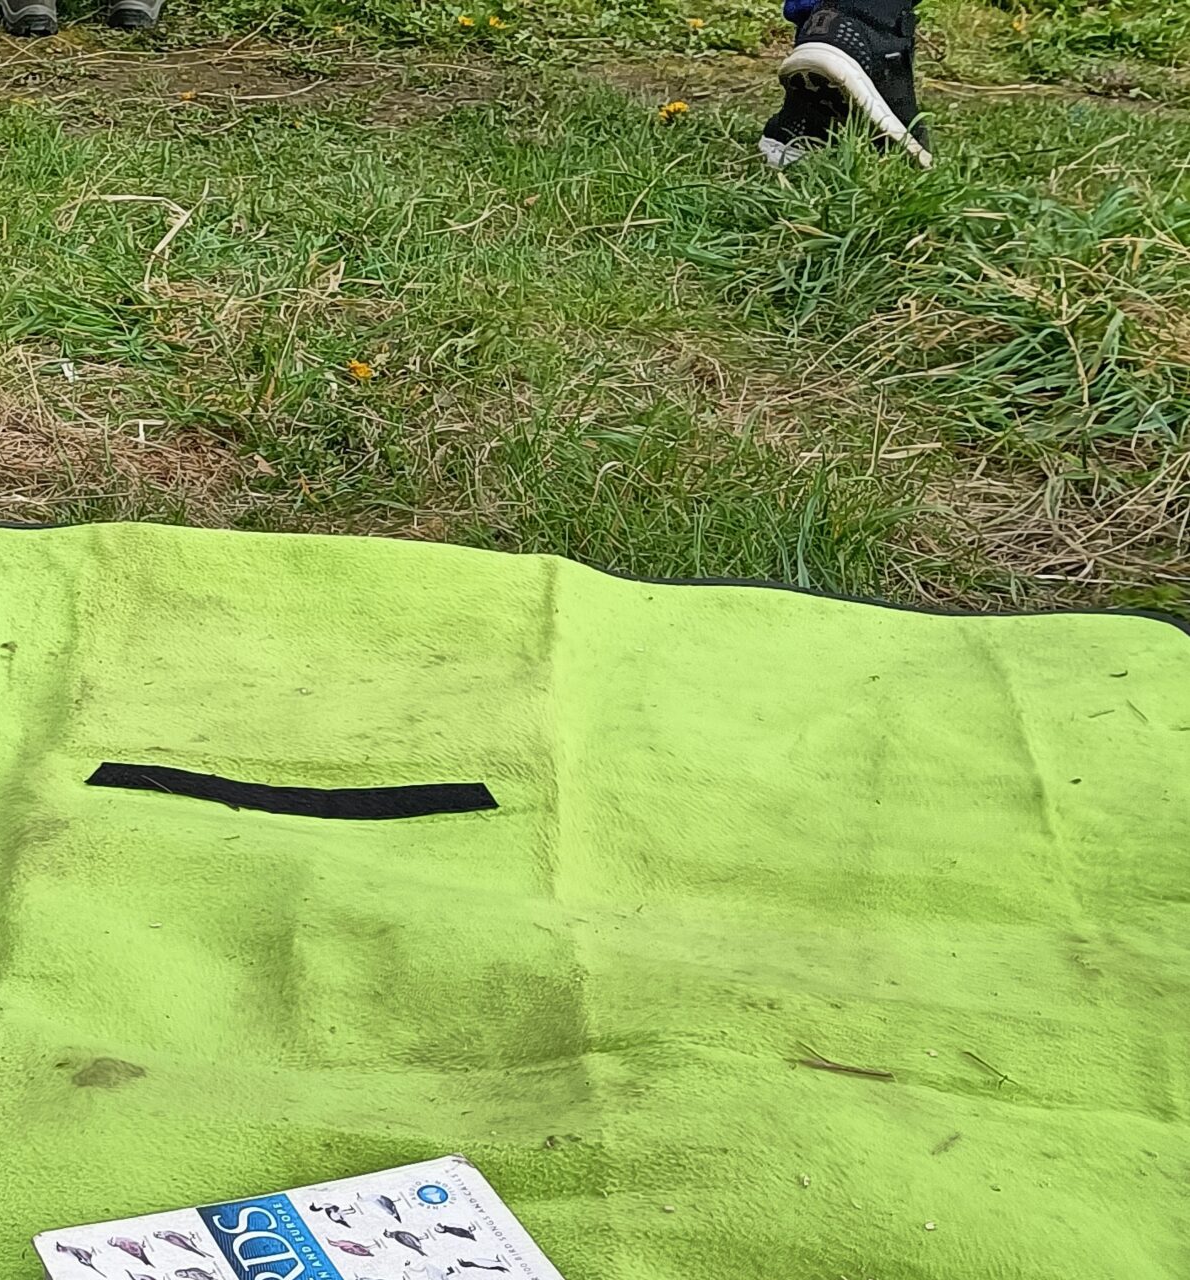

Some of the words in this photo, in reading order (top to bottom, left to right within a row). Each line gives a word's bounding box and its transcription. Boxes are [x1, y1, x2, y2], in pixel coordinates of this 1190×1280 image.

[468, 1196, 486, 1214] AND
[273, 1202, 306, 1243] EUROPE
[482, 1215, 506, 1242] SONGS
[301, 1246, 323, 1268] AND
[504, 1243, 523, 1262] BIRD
[519, 1262, 533, 1277] 100
